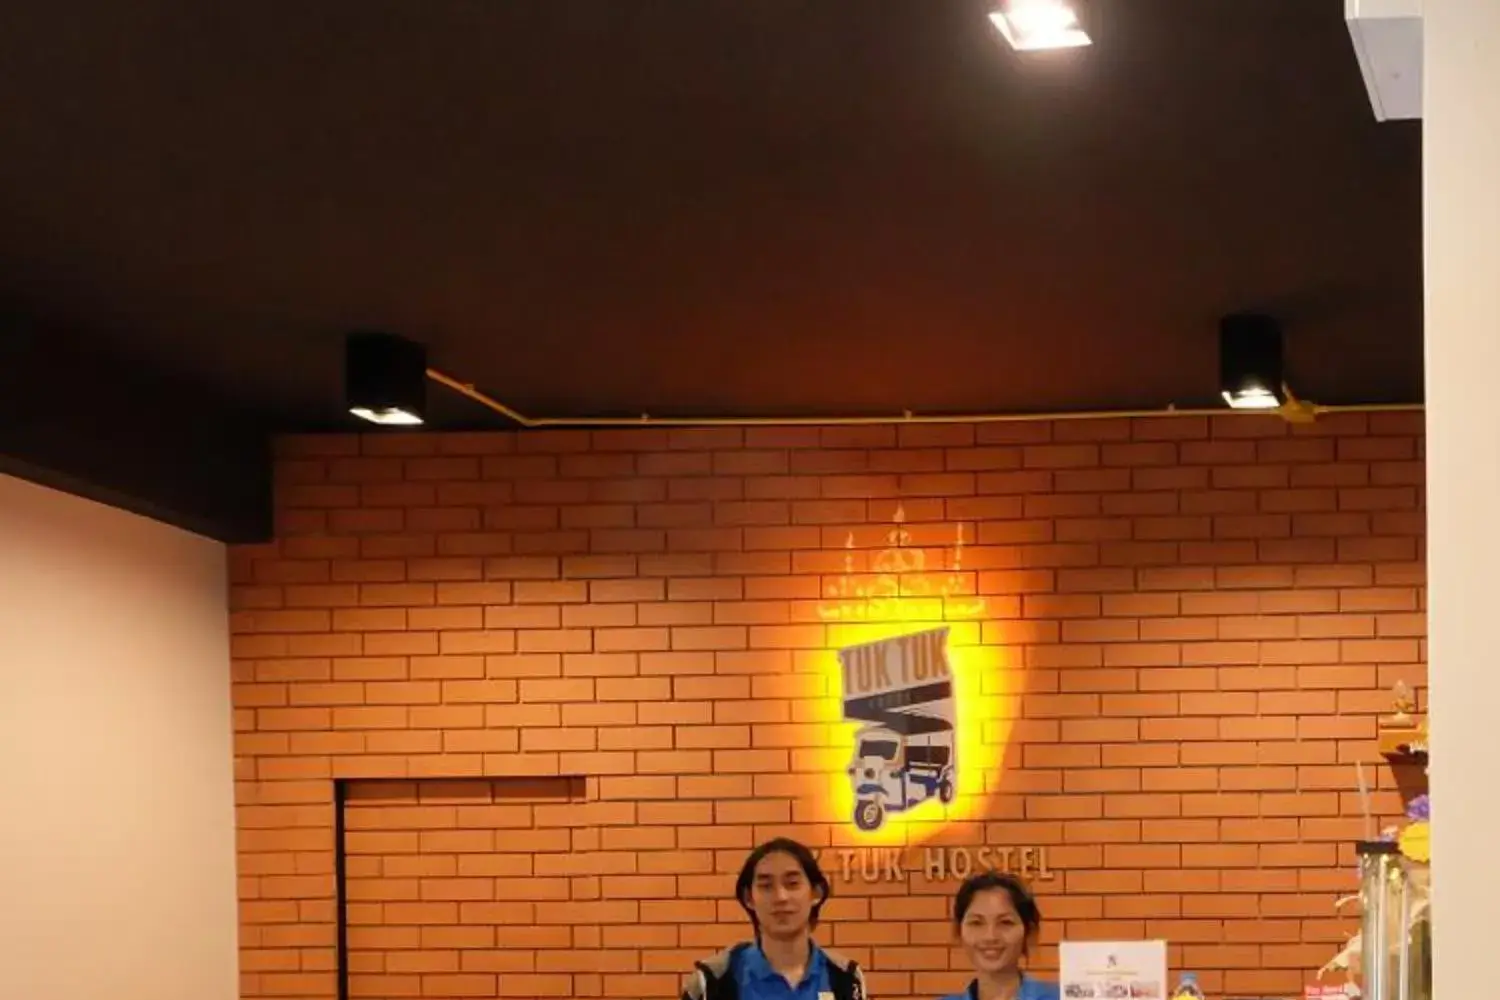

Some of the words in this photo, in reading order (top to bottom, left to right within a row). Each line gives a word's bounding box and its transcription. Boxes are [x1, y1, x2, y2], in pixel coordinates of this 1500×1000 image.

[840, 644, 892, 694] TUK
[897, 630, 949, 683] TUK
[839, 848, 905, 882] TUK
[925, 847, 1054, 881] HOSTEL
